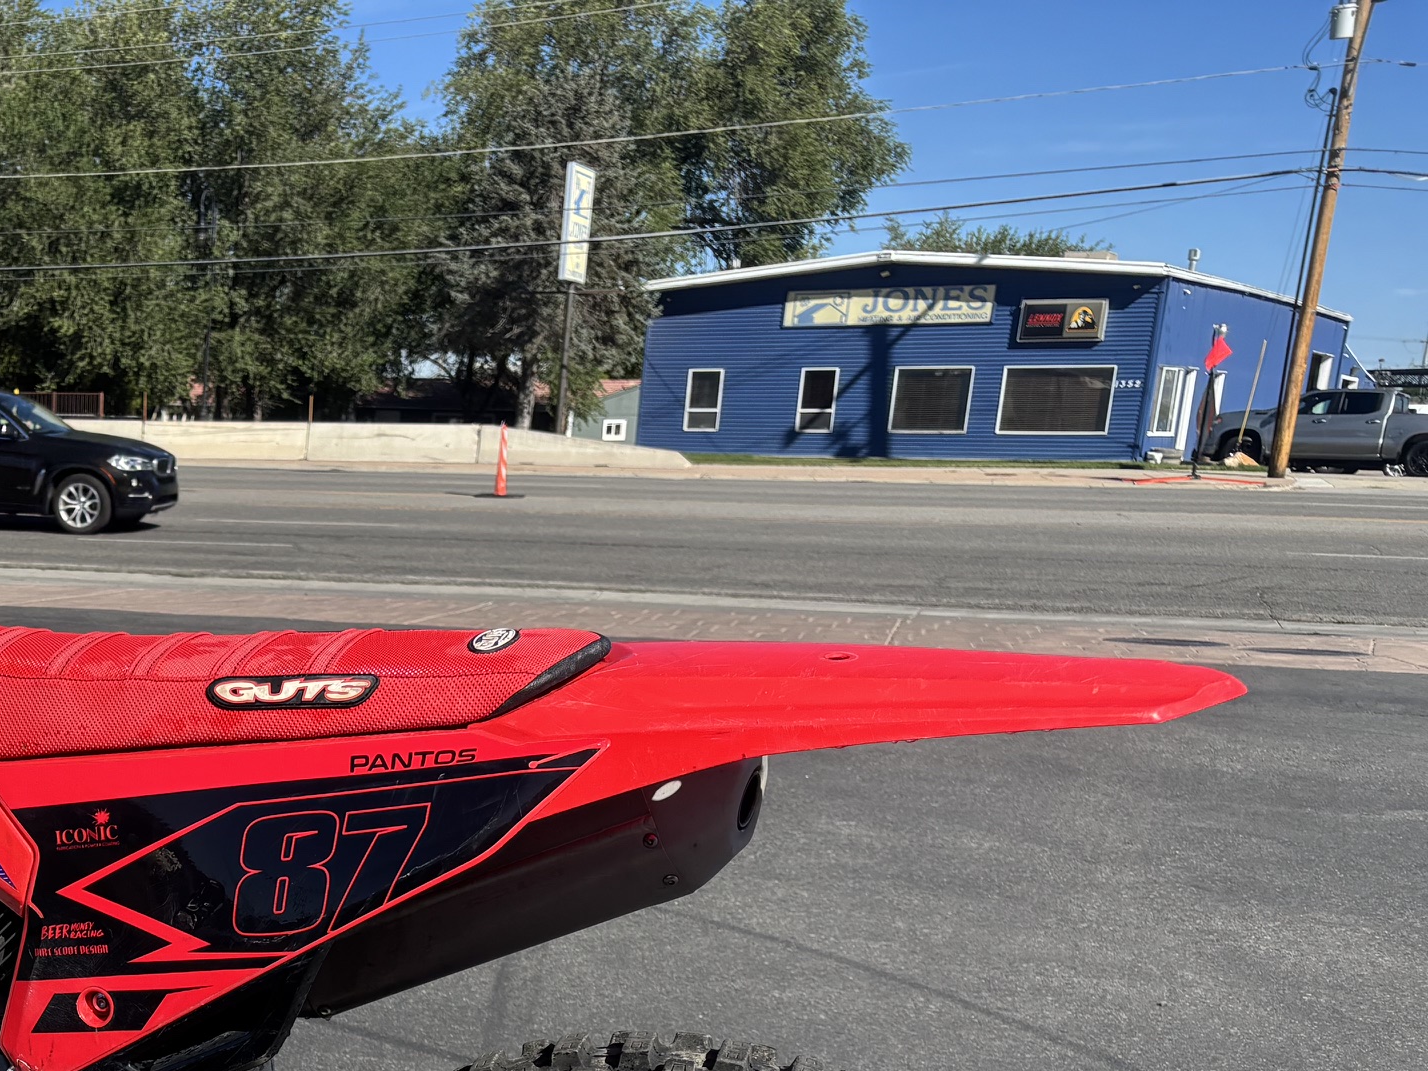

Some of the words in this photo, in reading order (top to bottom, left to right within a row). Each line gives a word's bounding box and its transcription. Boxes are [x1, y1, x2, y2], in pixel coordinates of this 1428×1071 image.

[862, 286, 988, 314] JONES
[922, 312, 989, 322] CONDITIONING
[213, 678, 371, 704] GUTS
[349, 748, 478, 773] PANTOS
[55, 824, 119, 845] ICONIC
[232, 801, 432, 937] 87
[41, 923, 70, 940] BEER
[70, 929, 104, 939] RACING
[34, 947, 52, 957] DIRT
[79, 944, 109, 955] DESIGN
